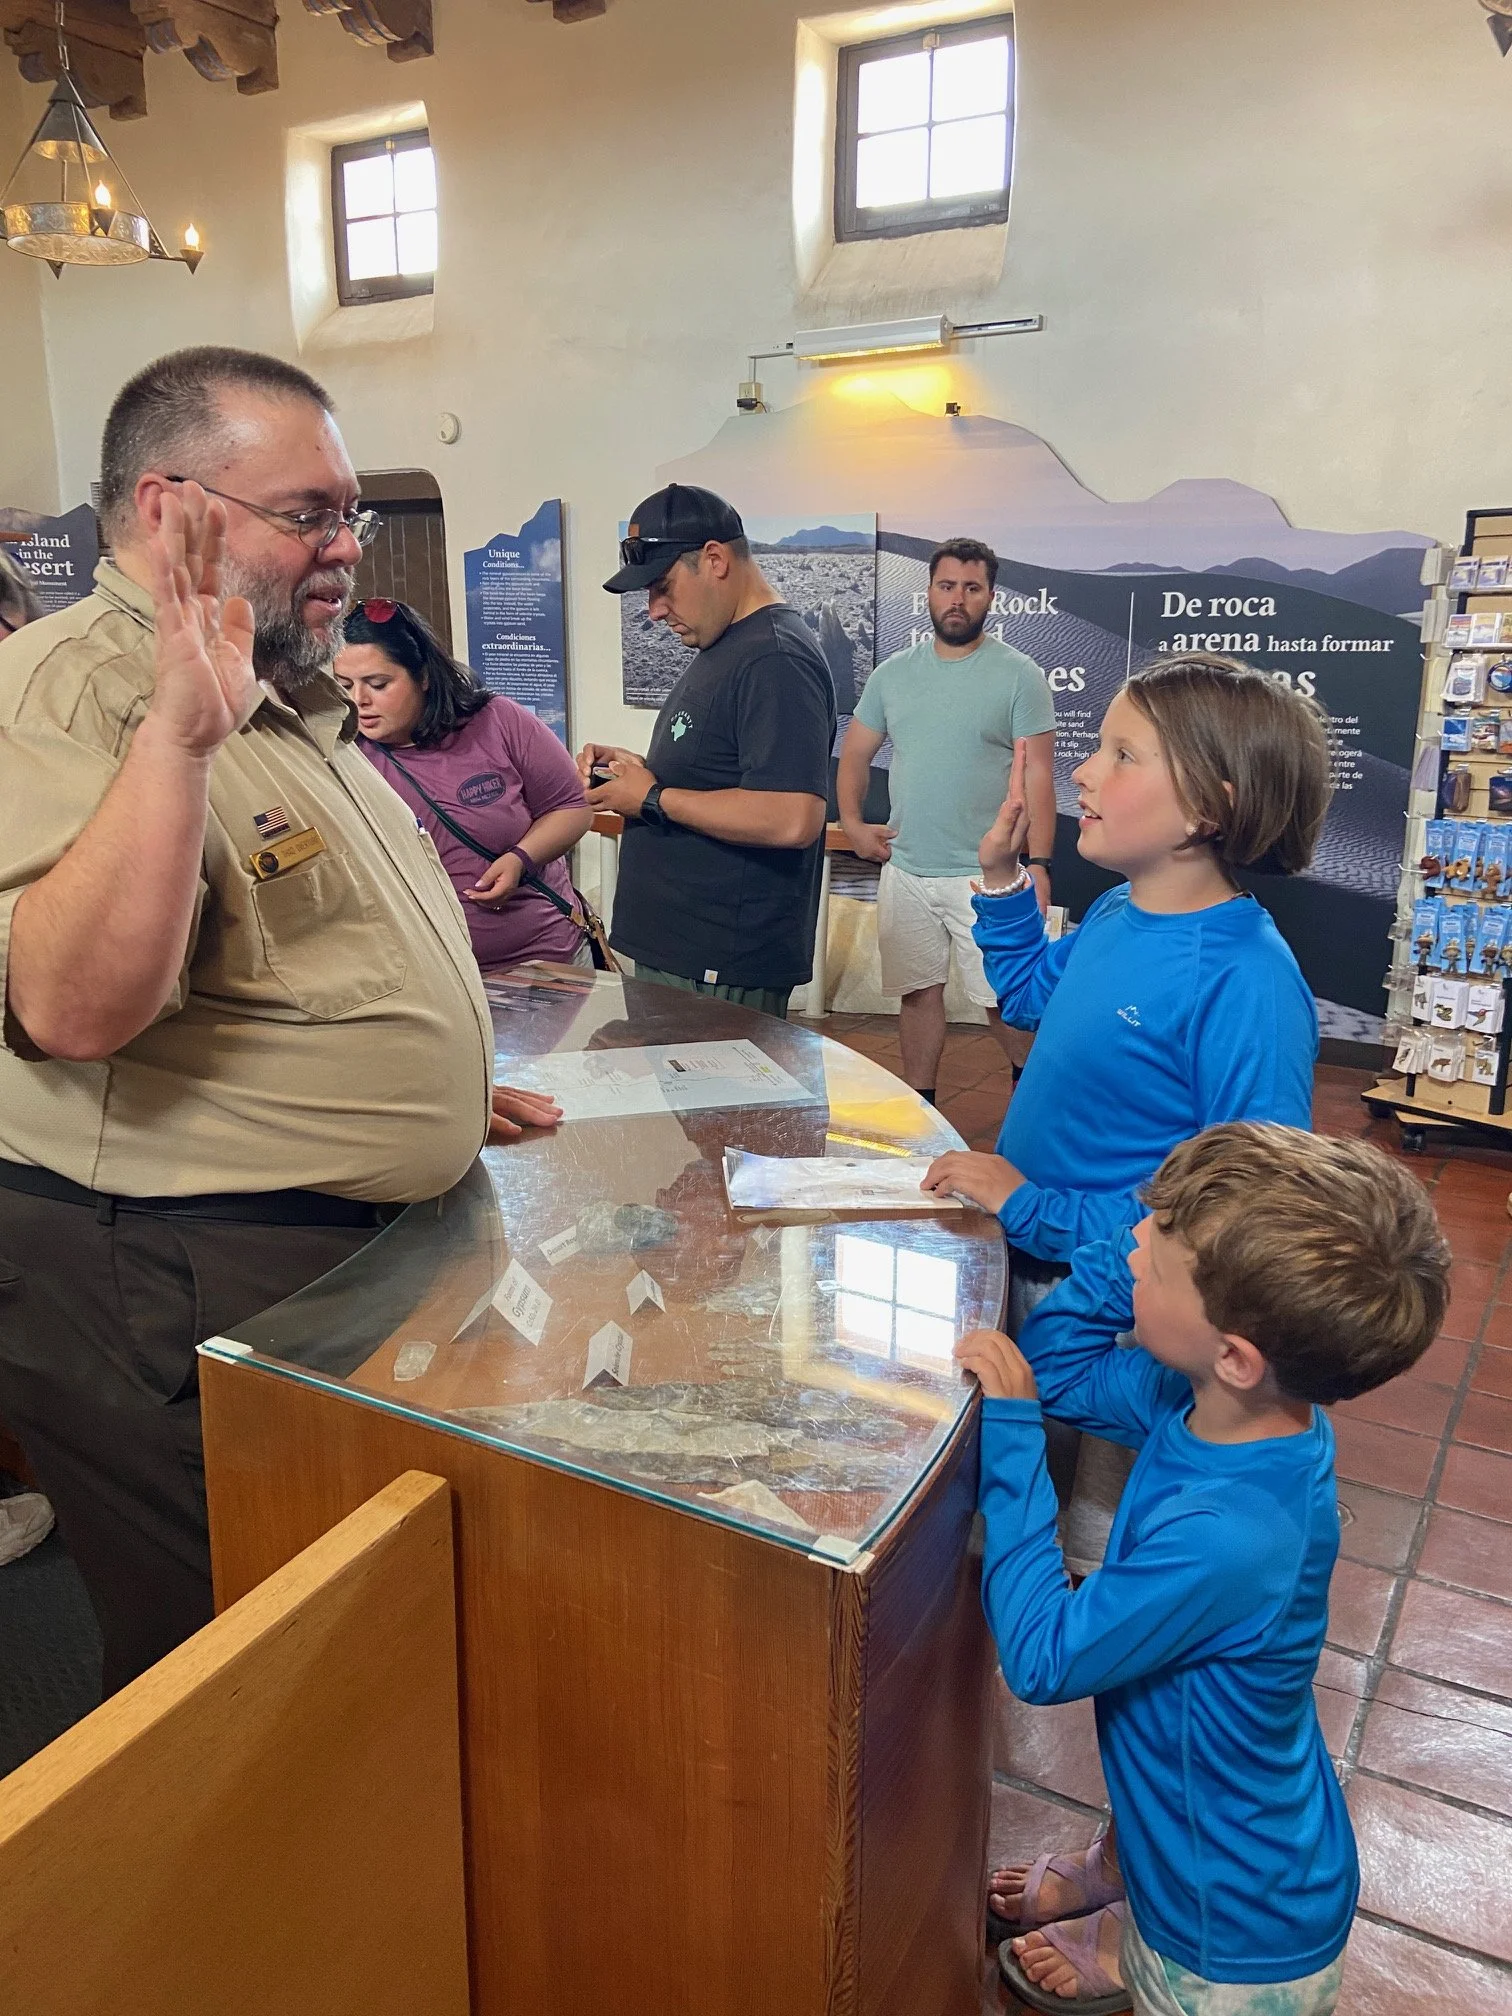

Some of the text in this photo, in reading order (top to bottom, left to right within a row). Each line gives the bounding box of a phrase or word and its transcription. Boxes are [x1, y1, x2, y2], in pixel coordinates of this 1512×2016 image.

[18, 548, 54, 560] in the
[488, 549, 520, 560] Unique
[482, 560, 524, 568] Conditions...
[988, 587, 1058, 616] Rock
[1160, 591, 1278, 618] De roca
[496, 633, 536, 641] Condiciones
[1158, 631, 1394, 652] a arena hasta formar
[482, 642, 551, 651] extraordinarias...
[1072, 731, 1099, 739] Perhaps
[1067, 741, 1079, 749] slip
[1074, 750, 1090, 759] high
[512, 1285, 532, 1318] Gypsum
